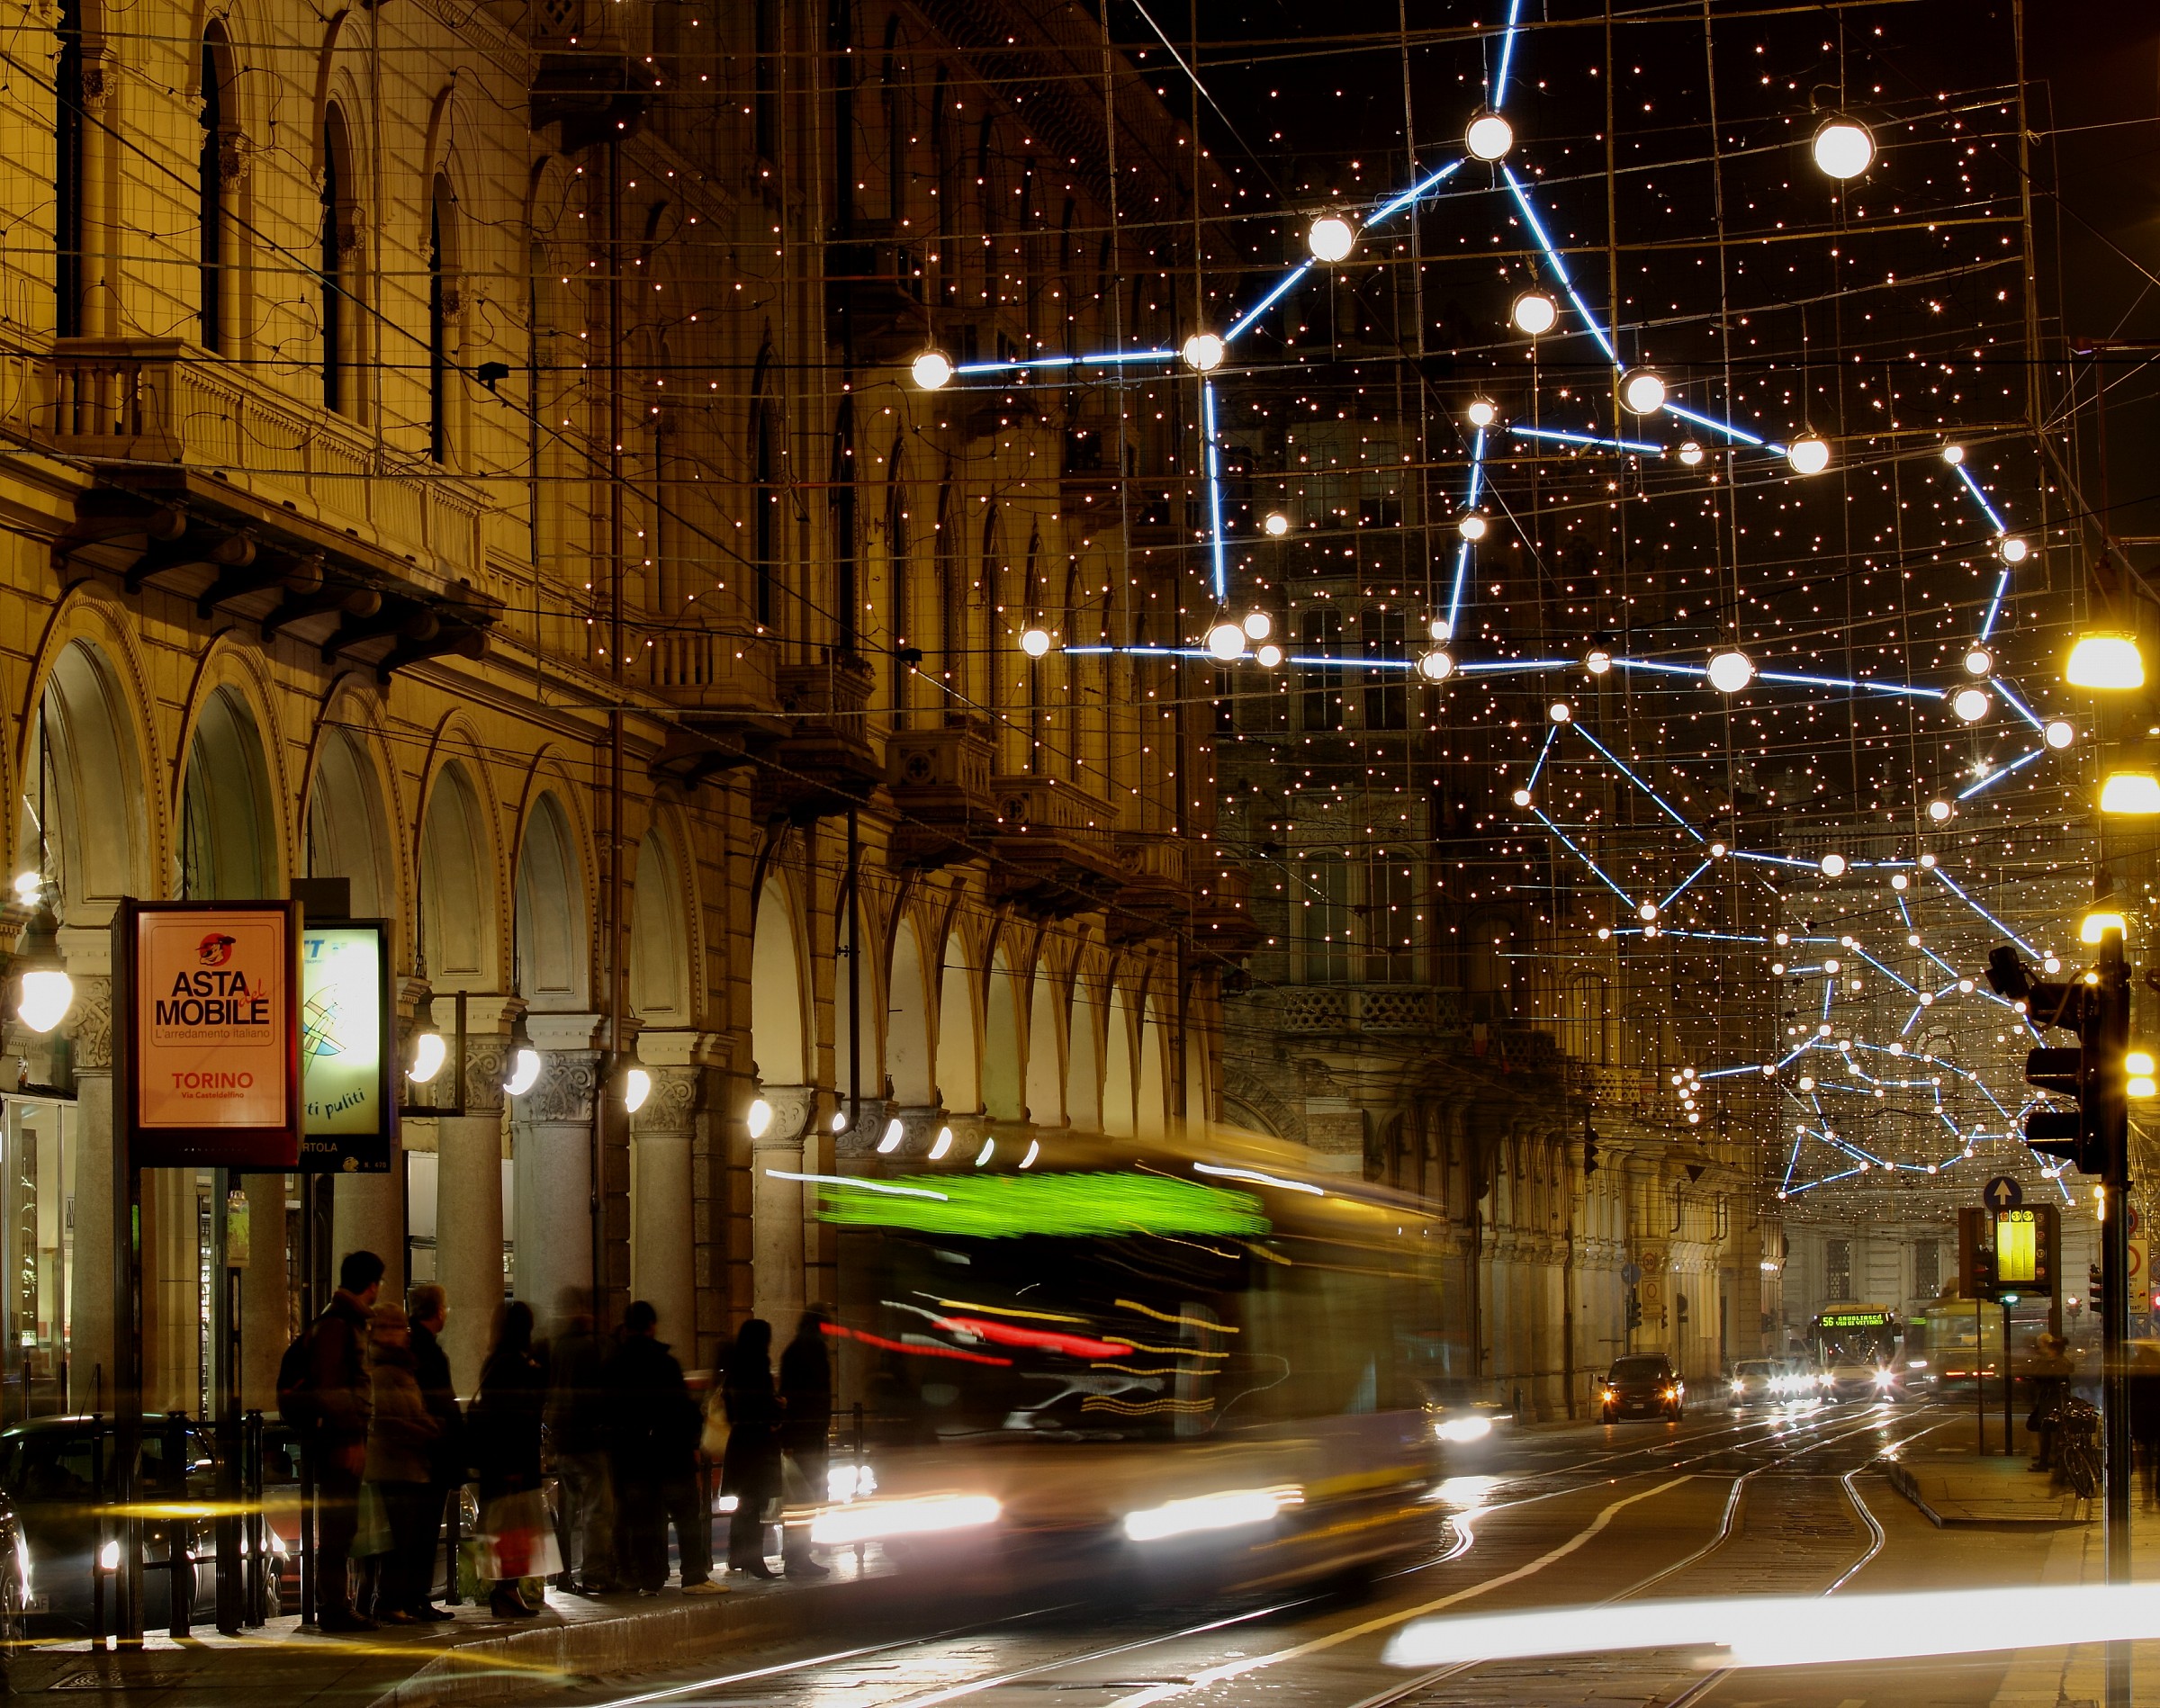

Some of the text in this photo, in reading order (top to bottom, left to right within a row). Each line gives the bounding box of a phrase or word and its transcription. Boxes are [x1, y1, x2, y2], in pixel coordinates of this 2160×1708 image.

[171, 970, 250, 997] ASTA
[238, 978, 266, 1008] del
[156, 999, 270, 1026] MOBILE
[156, 1028, 270, 1038] L'arredamento italiano
[171, 1072, 253, 1089] TORINO
[195, 1091, 244, 1099] Casteldelfino
[325, 1087, 365, 1120] puliti
[302, 1142, 338, 1153] RTOLA
[1822, 1317, 1834, 1327] 56
